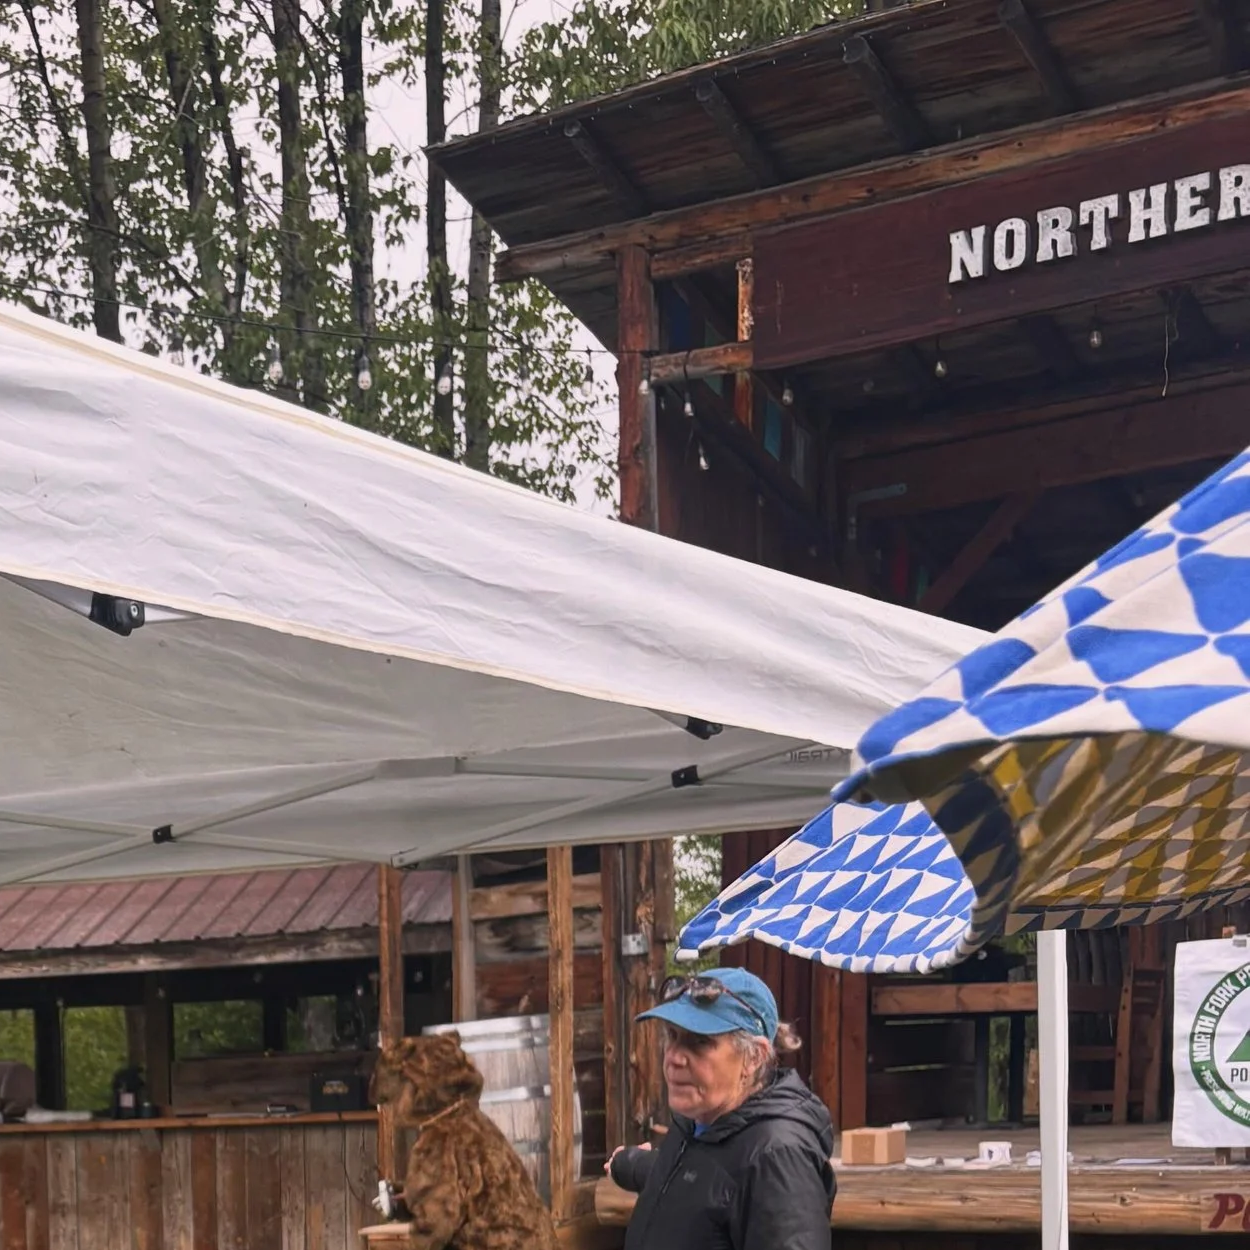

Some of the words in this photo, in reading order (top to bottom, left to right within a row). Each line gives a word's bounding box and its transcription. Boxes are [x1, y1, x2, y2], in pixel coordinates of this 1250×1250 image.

[949, 164, 1250, 283] NORTHER
[1203, 977, 1240, 1015] FORK
[1192, 1014, 1217, 1063] NORTH
[1231, 1067, 1248, 1083] PO
